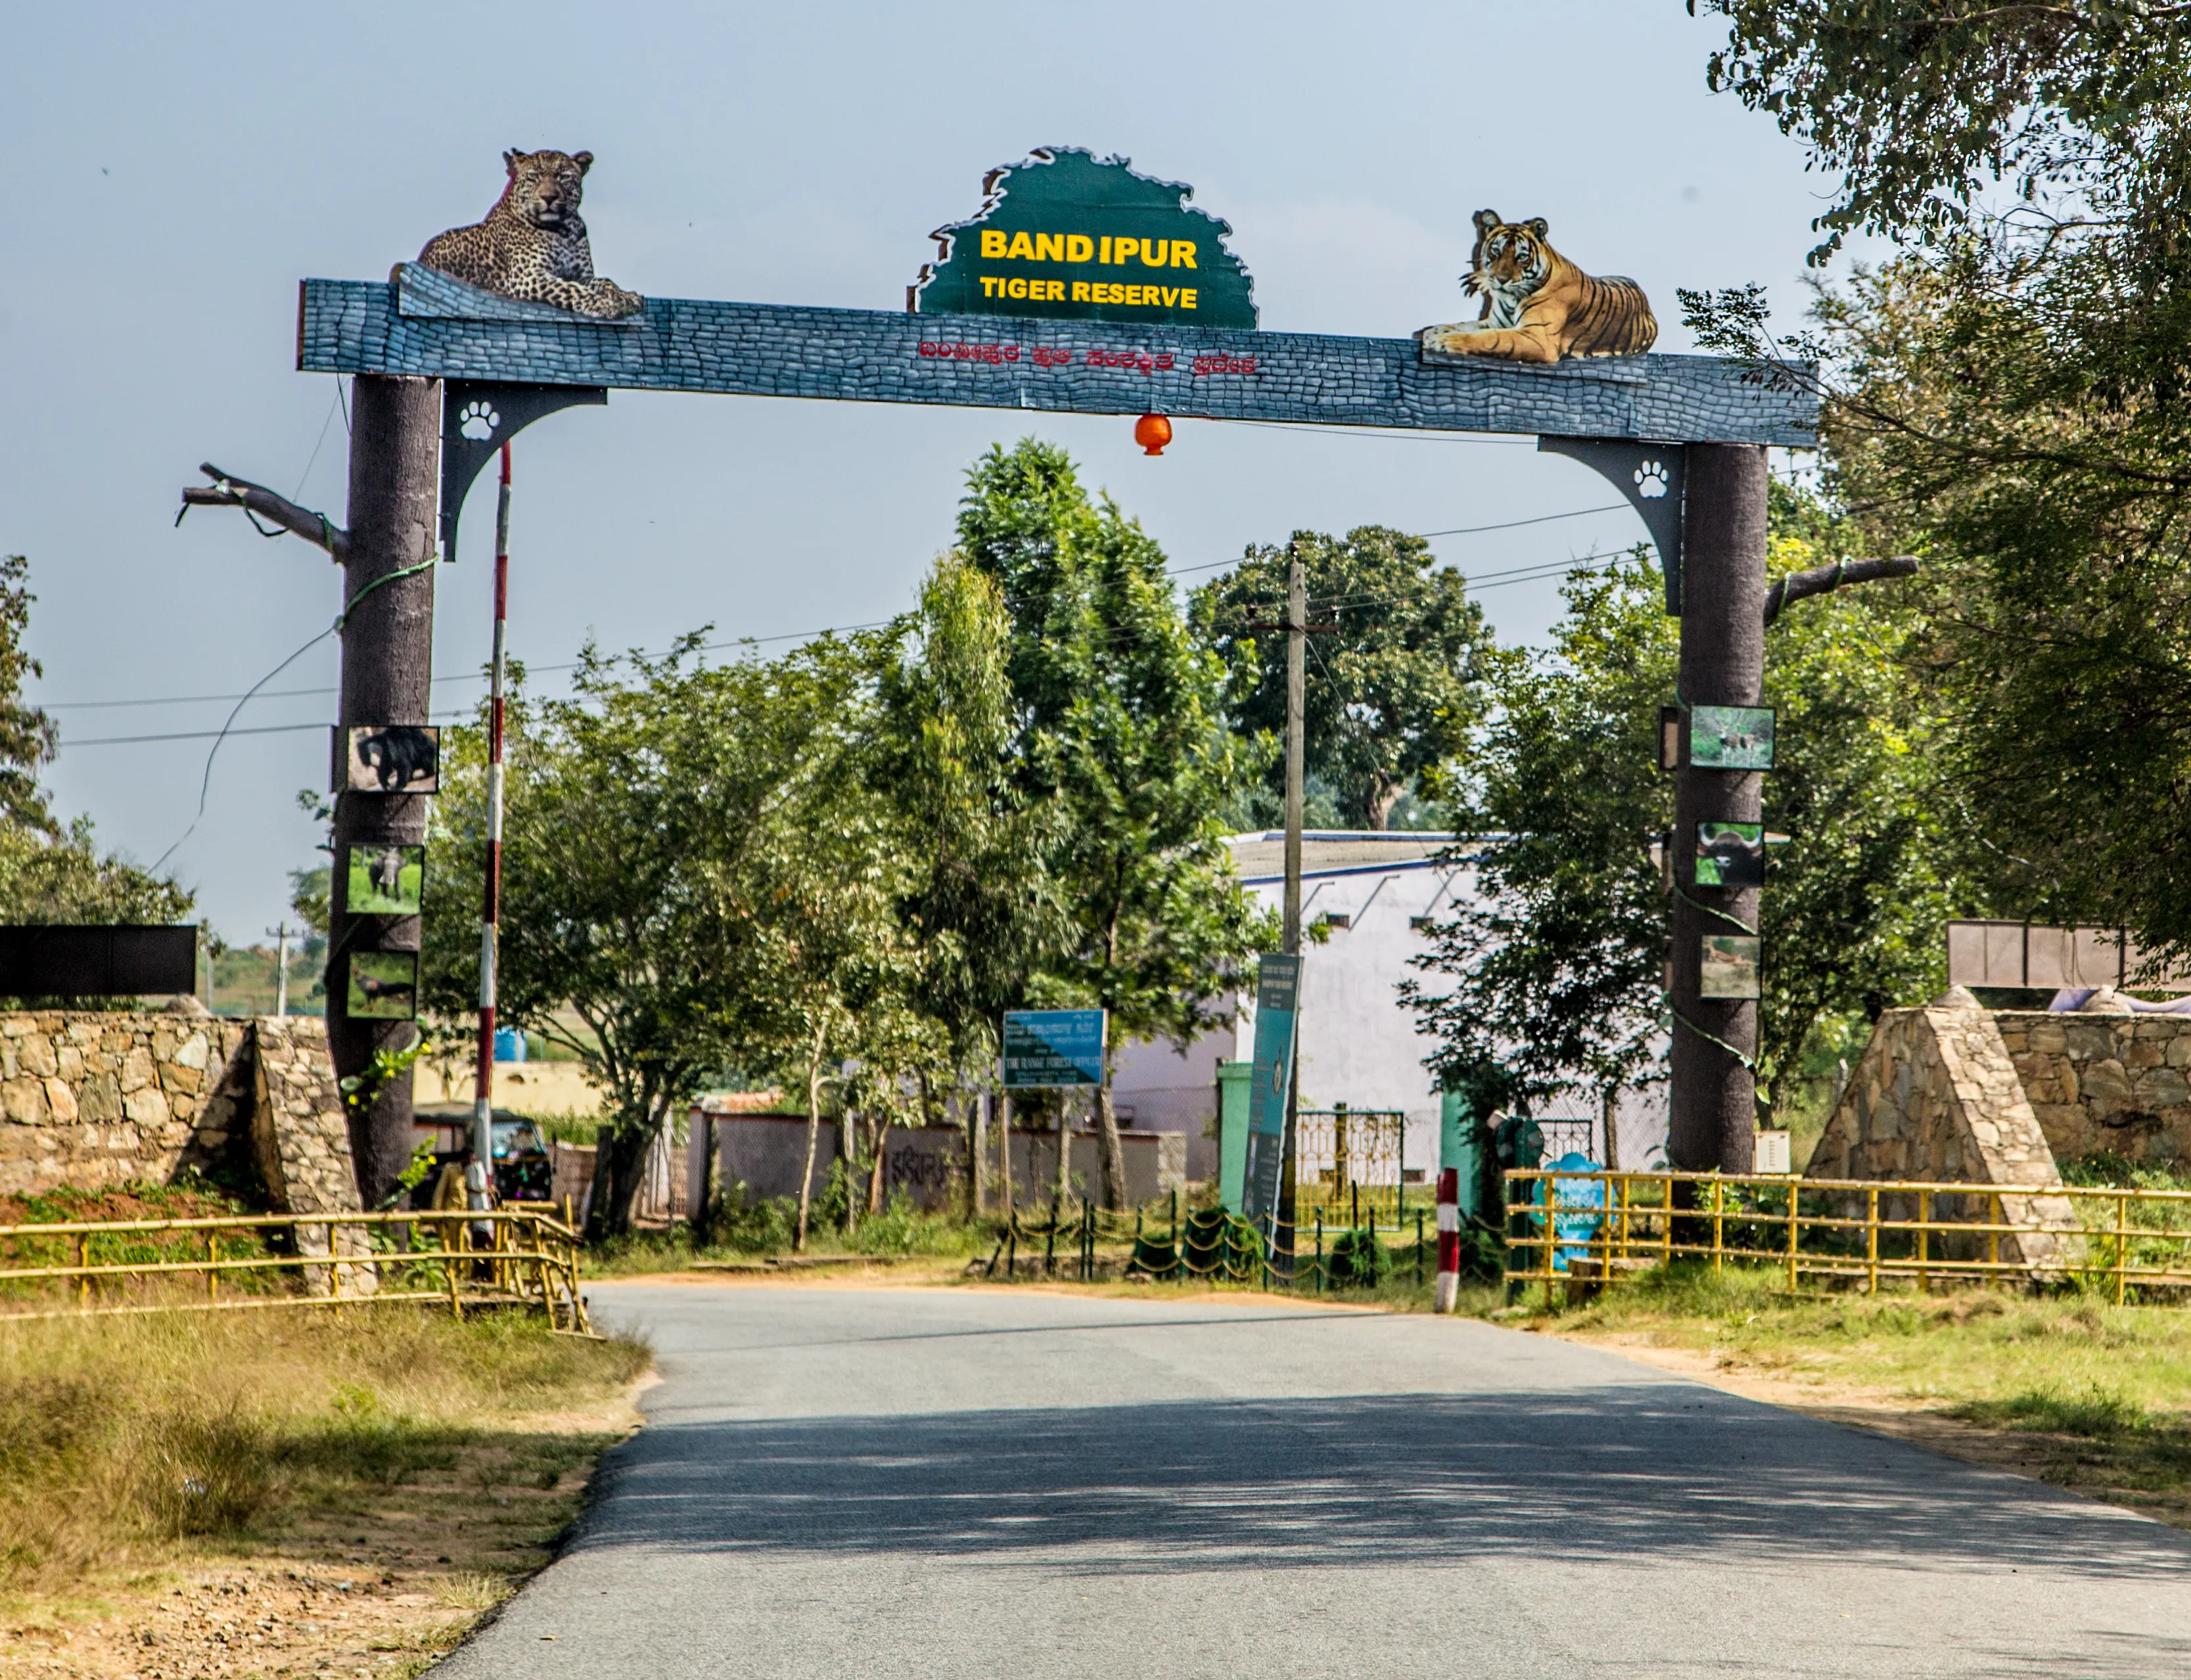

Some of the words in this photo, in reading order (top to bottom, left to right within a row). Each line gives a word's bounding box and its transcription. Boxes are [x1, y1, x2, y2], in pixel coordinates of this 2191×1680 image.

[980, 229, 1197, 269] BANDIPUR
[979, 276, 1066, 302] TIGER
[1072, 281, 1197, 309] RESERVE
